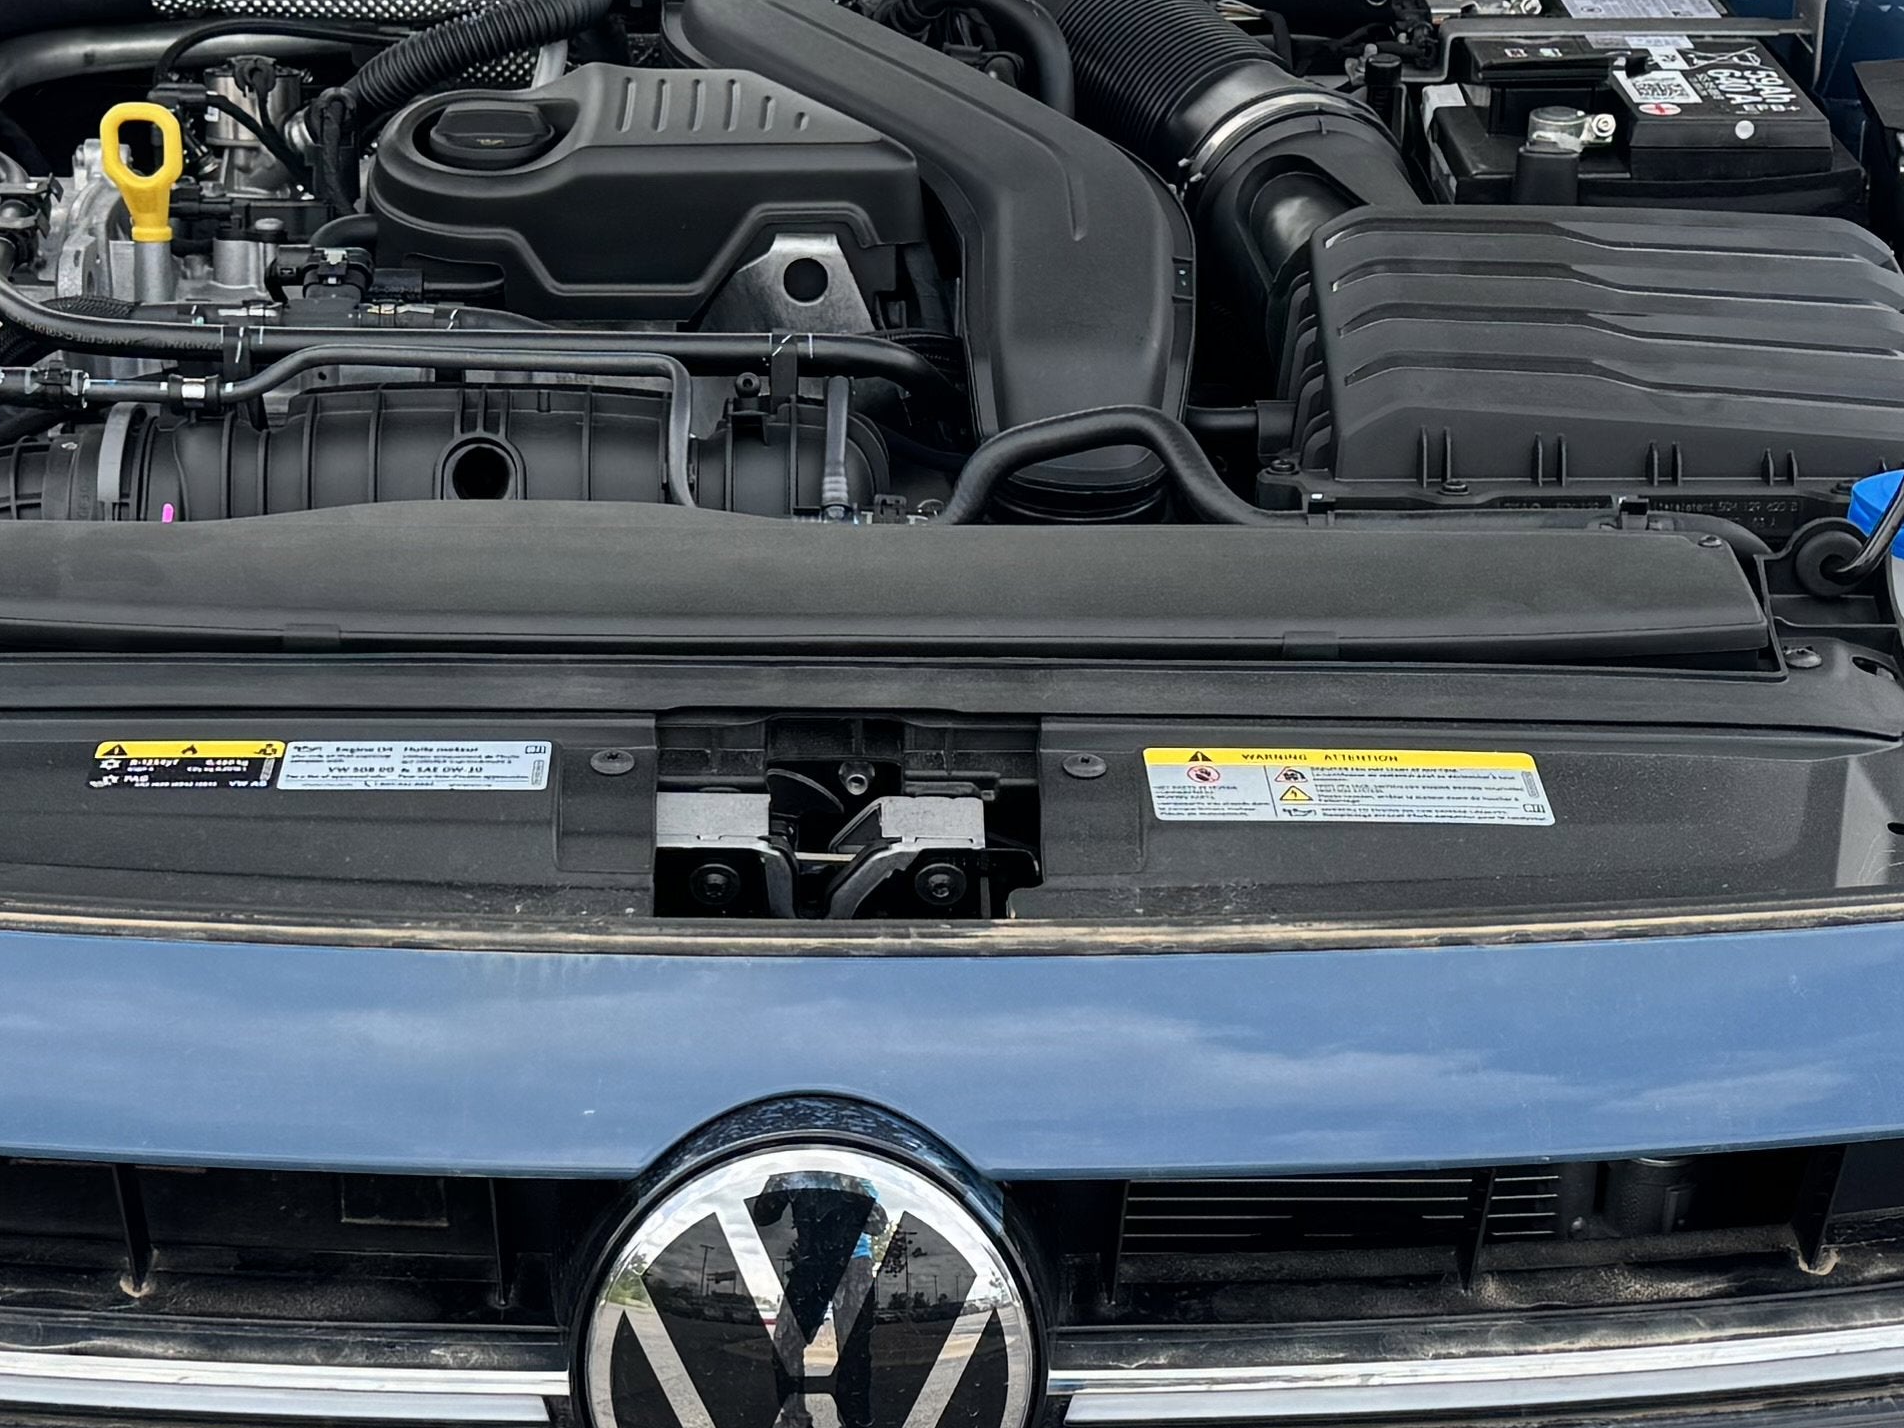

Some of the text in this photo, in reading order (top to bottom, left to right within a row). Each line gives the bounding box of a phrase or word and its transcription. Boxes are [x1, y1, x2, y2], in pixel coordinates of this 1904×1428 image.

[1241, 753, 1399, 763] WARNING ATTENTION
[228, 780, 249, 788] VW
